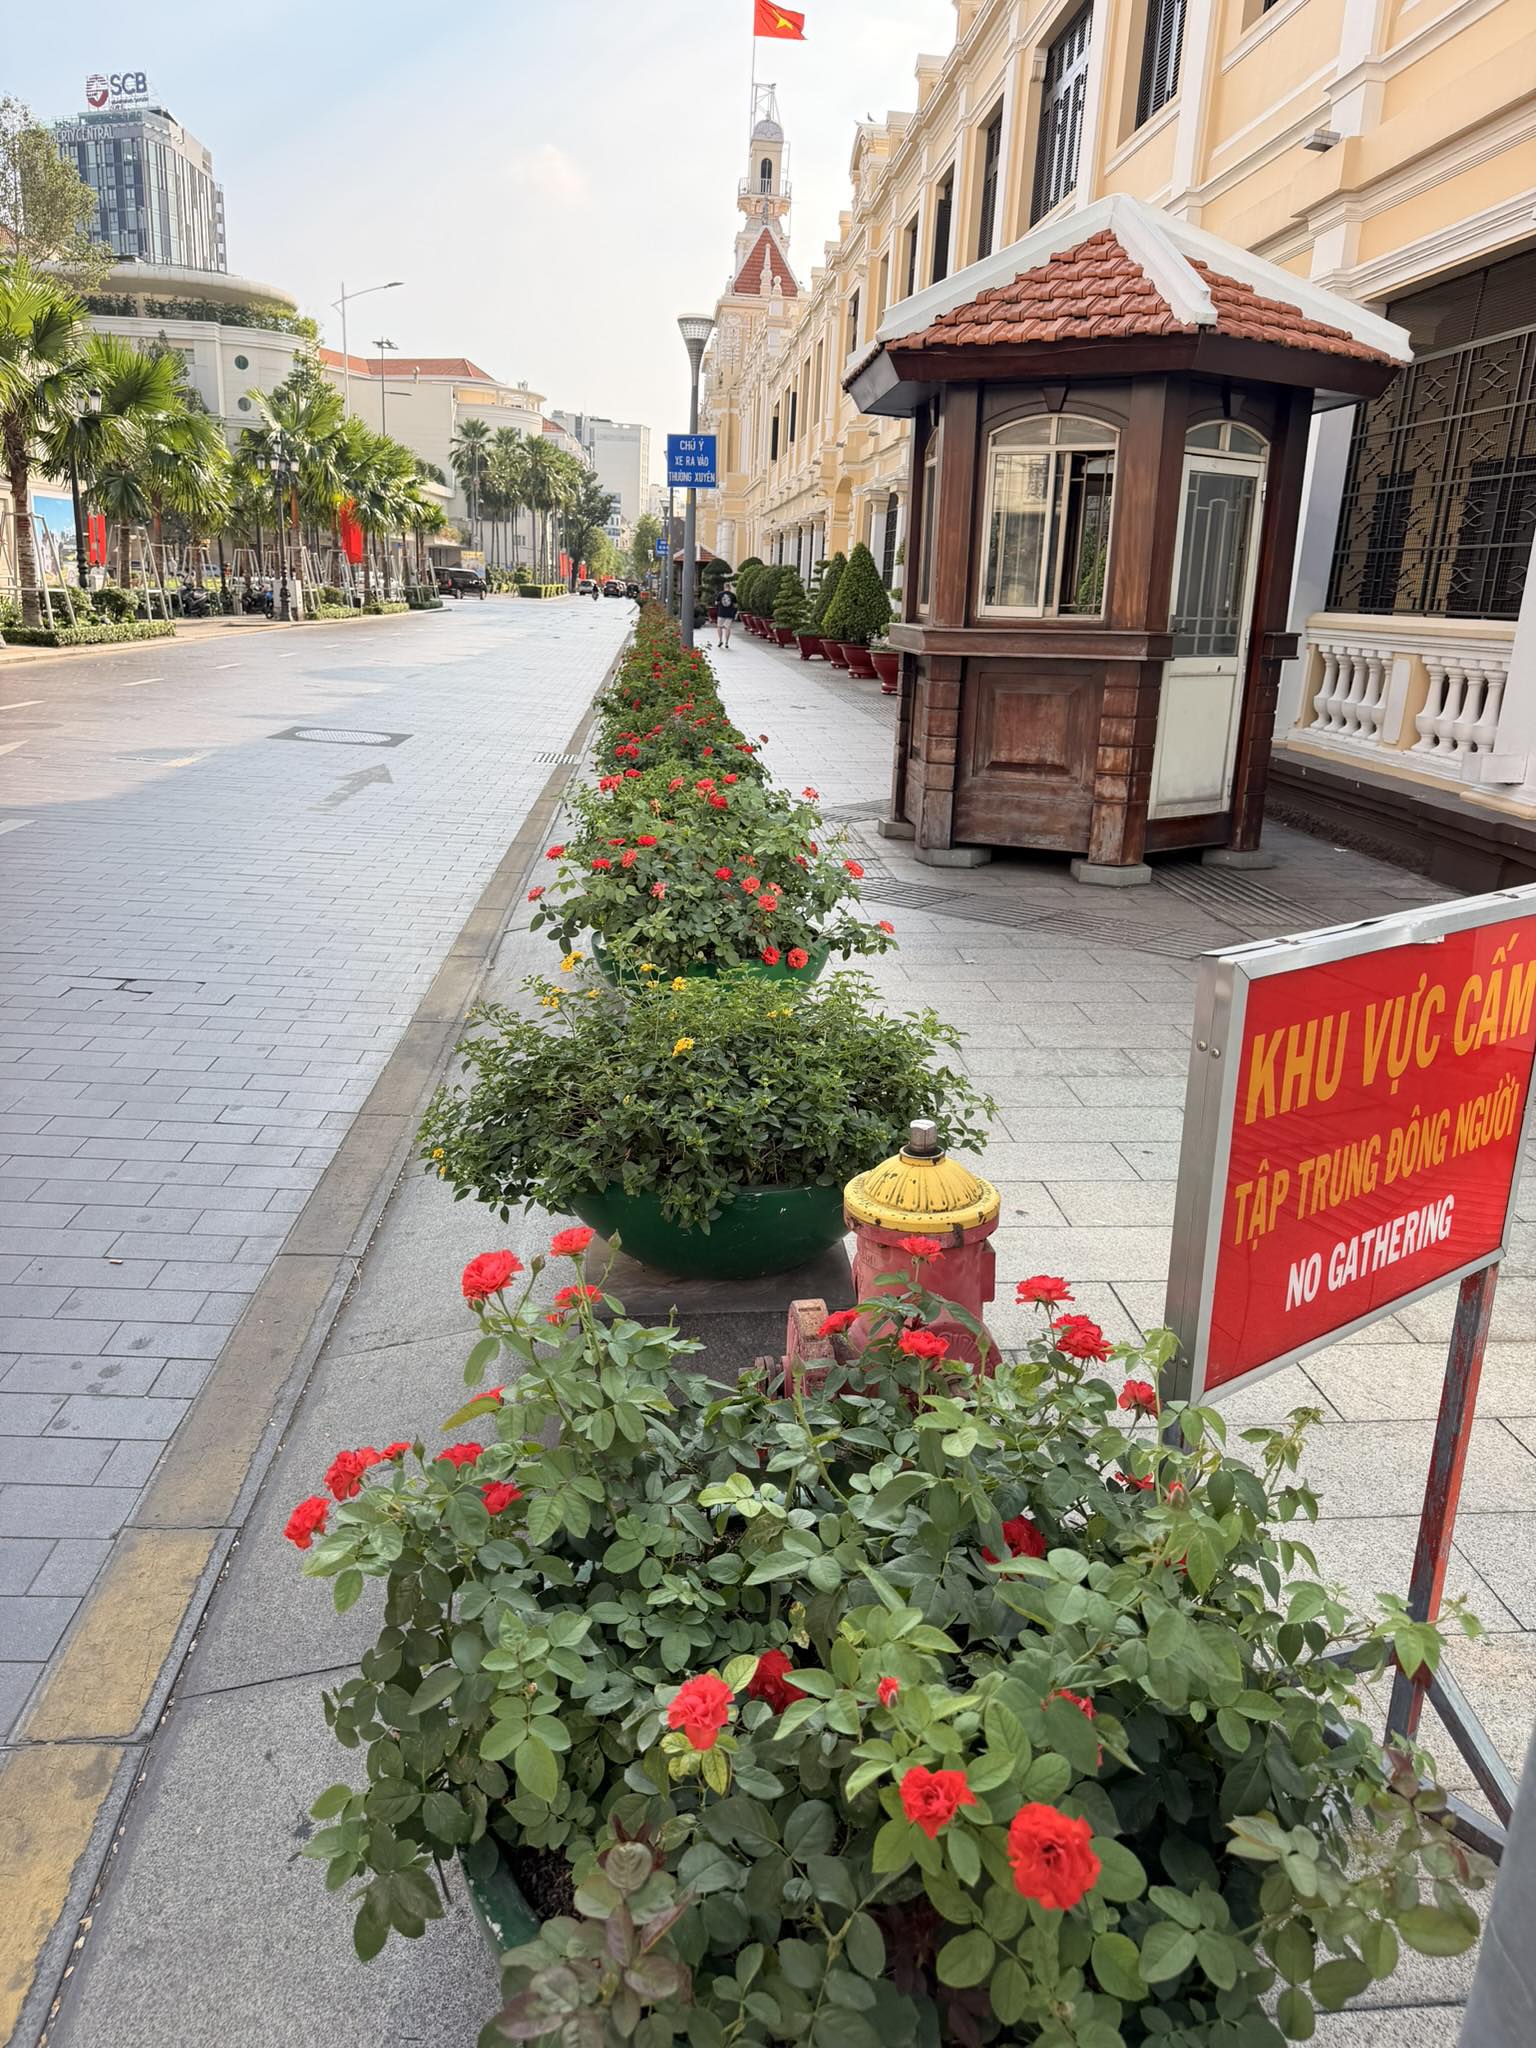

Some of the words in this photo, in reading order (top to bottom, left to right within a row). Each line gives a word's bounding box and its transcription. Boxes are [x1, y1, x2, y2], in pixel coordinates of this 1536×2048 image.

[110, 72, 147, 95] SCB
[76, 124, 114, 141] CENTRAL
[680, 438, 696, 451] CHÚ
[675, 456, 683, 466] XE
[686, 456, 695, 466] RA
[697, 454, 709, 467] VÀO
[1245, 1010, 1350, 1125] KHU
[1362, 973, 1446, 1095] VỰC
[1453, 932, 1536, 1056] CẤM
[1234, 1158, 1290, 1250] TẬP
[1297, 1134, 1381, 1220] TRUNG
[1384, 1104, 1450, 1185] ĐÔNG
[1452, 1072, 1521, 1157] NGƯỜI
[1285, 1252, 1322, 1312] NO
[1328, 1194, 1455, 1292] GATHERING
